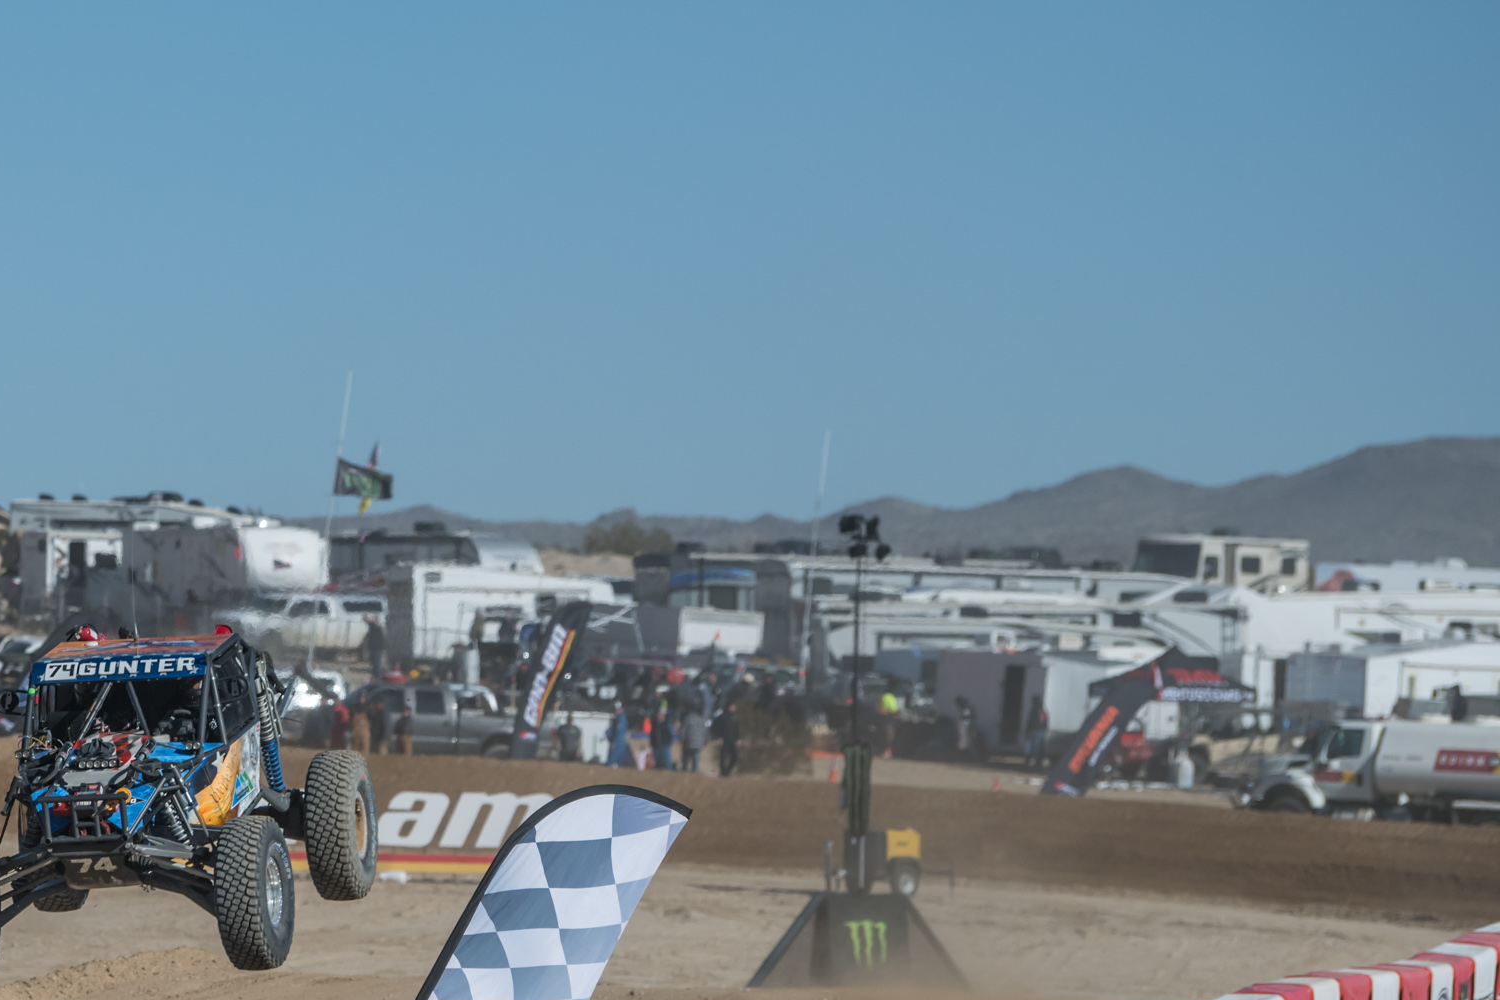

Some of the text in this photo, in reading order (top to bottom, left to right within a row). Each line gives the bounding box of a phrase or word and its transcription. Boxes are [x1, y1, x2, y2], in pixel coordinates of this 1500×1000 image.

[49, 657, 195, 678] 74 GUNTER
[70, 857, 117, 874] 74
